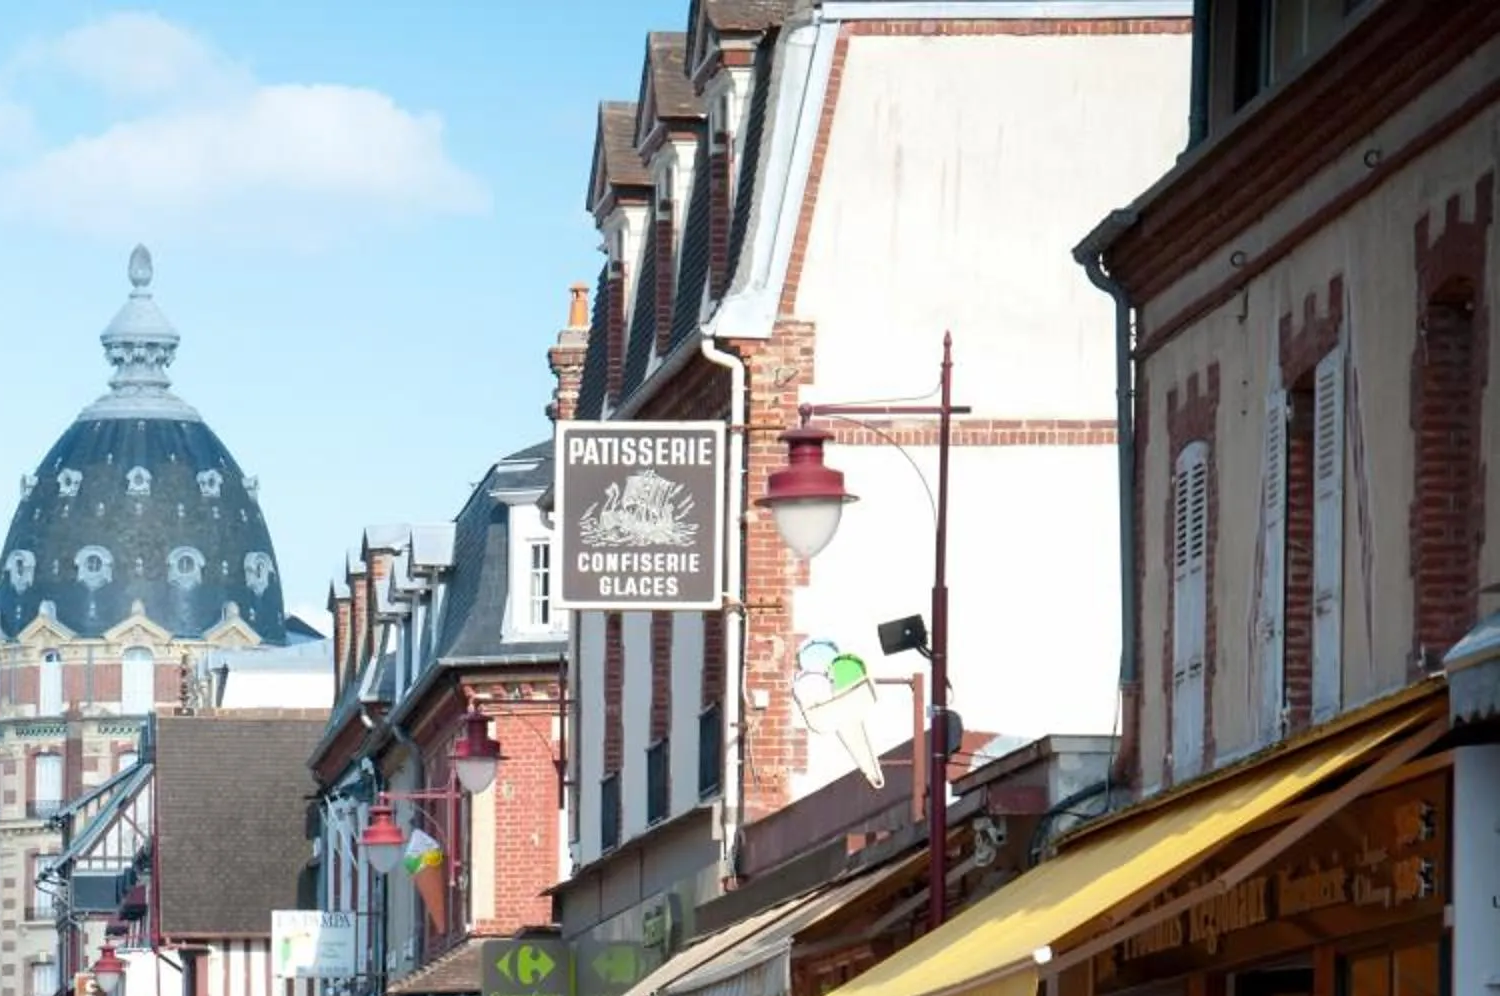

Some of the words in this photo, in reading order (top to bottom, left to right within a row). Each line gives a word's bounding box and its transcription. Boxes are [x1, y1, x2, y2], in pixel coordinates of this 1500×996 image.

[569, 437, 712, 465] PATISSERIE
[578, 552, 700, 573] CONFISERIE
[599, 576, 678, 595] GLACES
